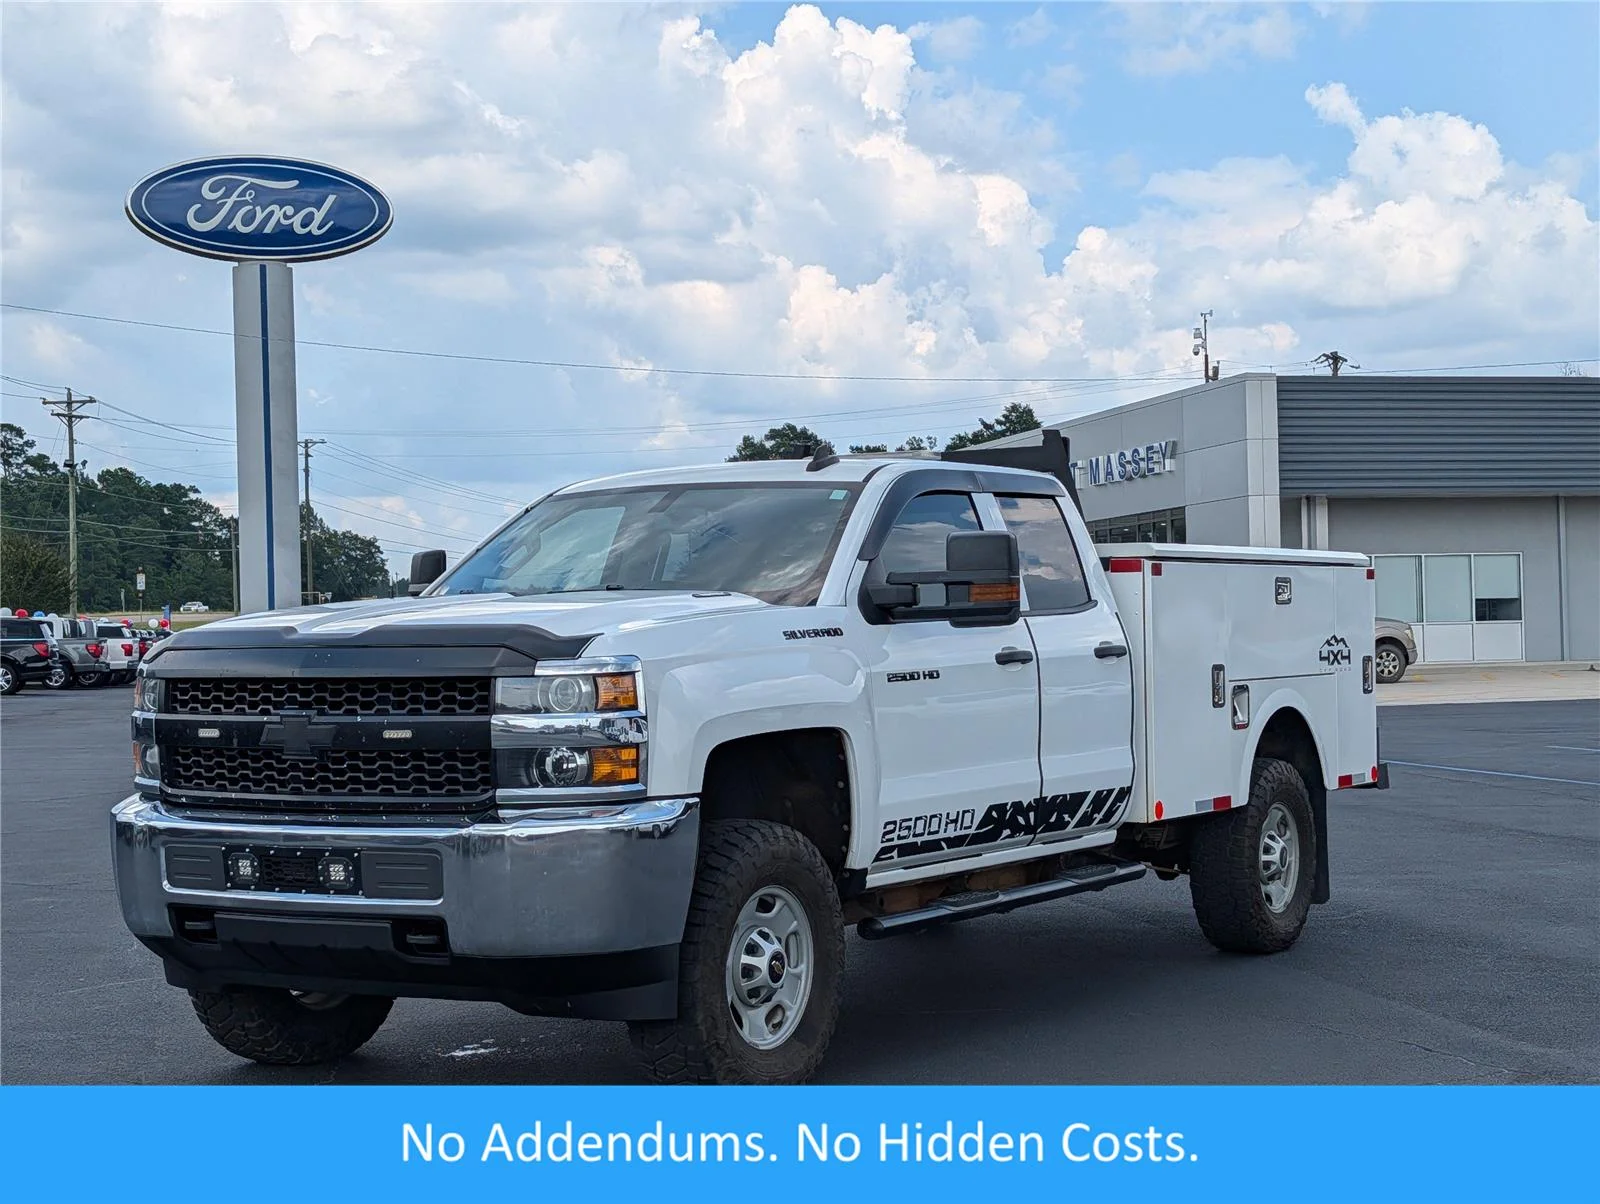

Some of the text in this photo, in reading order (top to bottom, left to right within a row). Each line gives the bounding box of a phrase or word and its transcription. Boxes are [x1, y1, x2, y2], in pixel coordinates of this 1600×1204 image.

[187, 174, 338, 235] Ford
[1089, 440, 1172, 486] MASSEY
[783, 627, 844, 640] SILVERADO
[886, 669, 940, 683] 2500 HD
